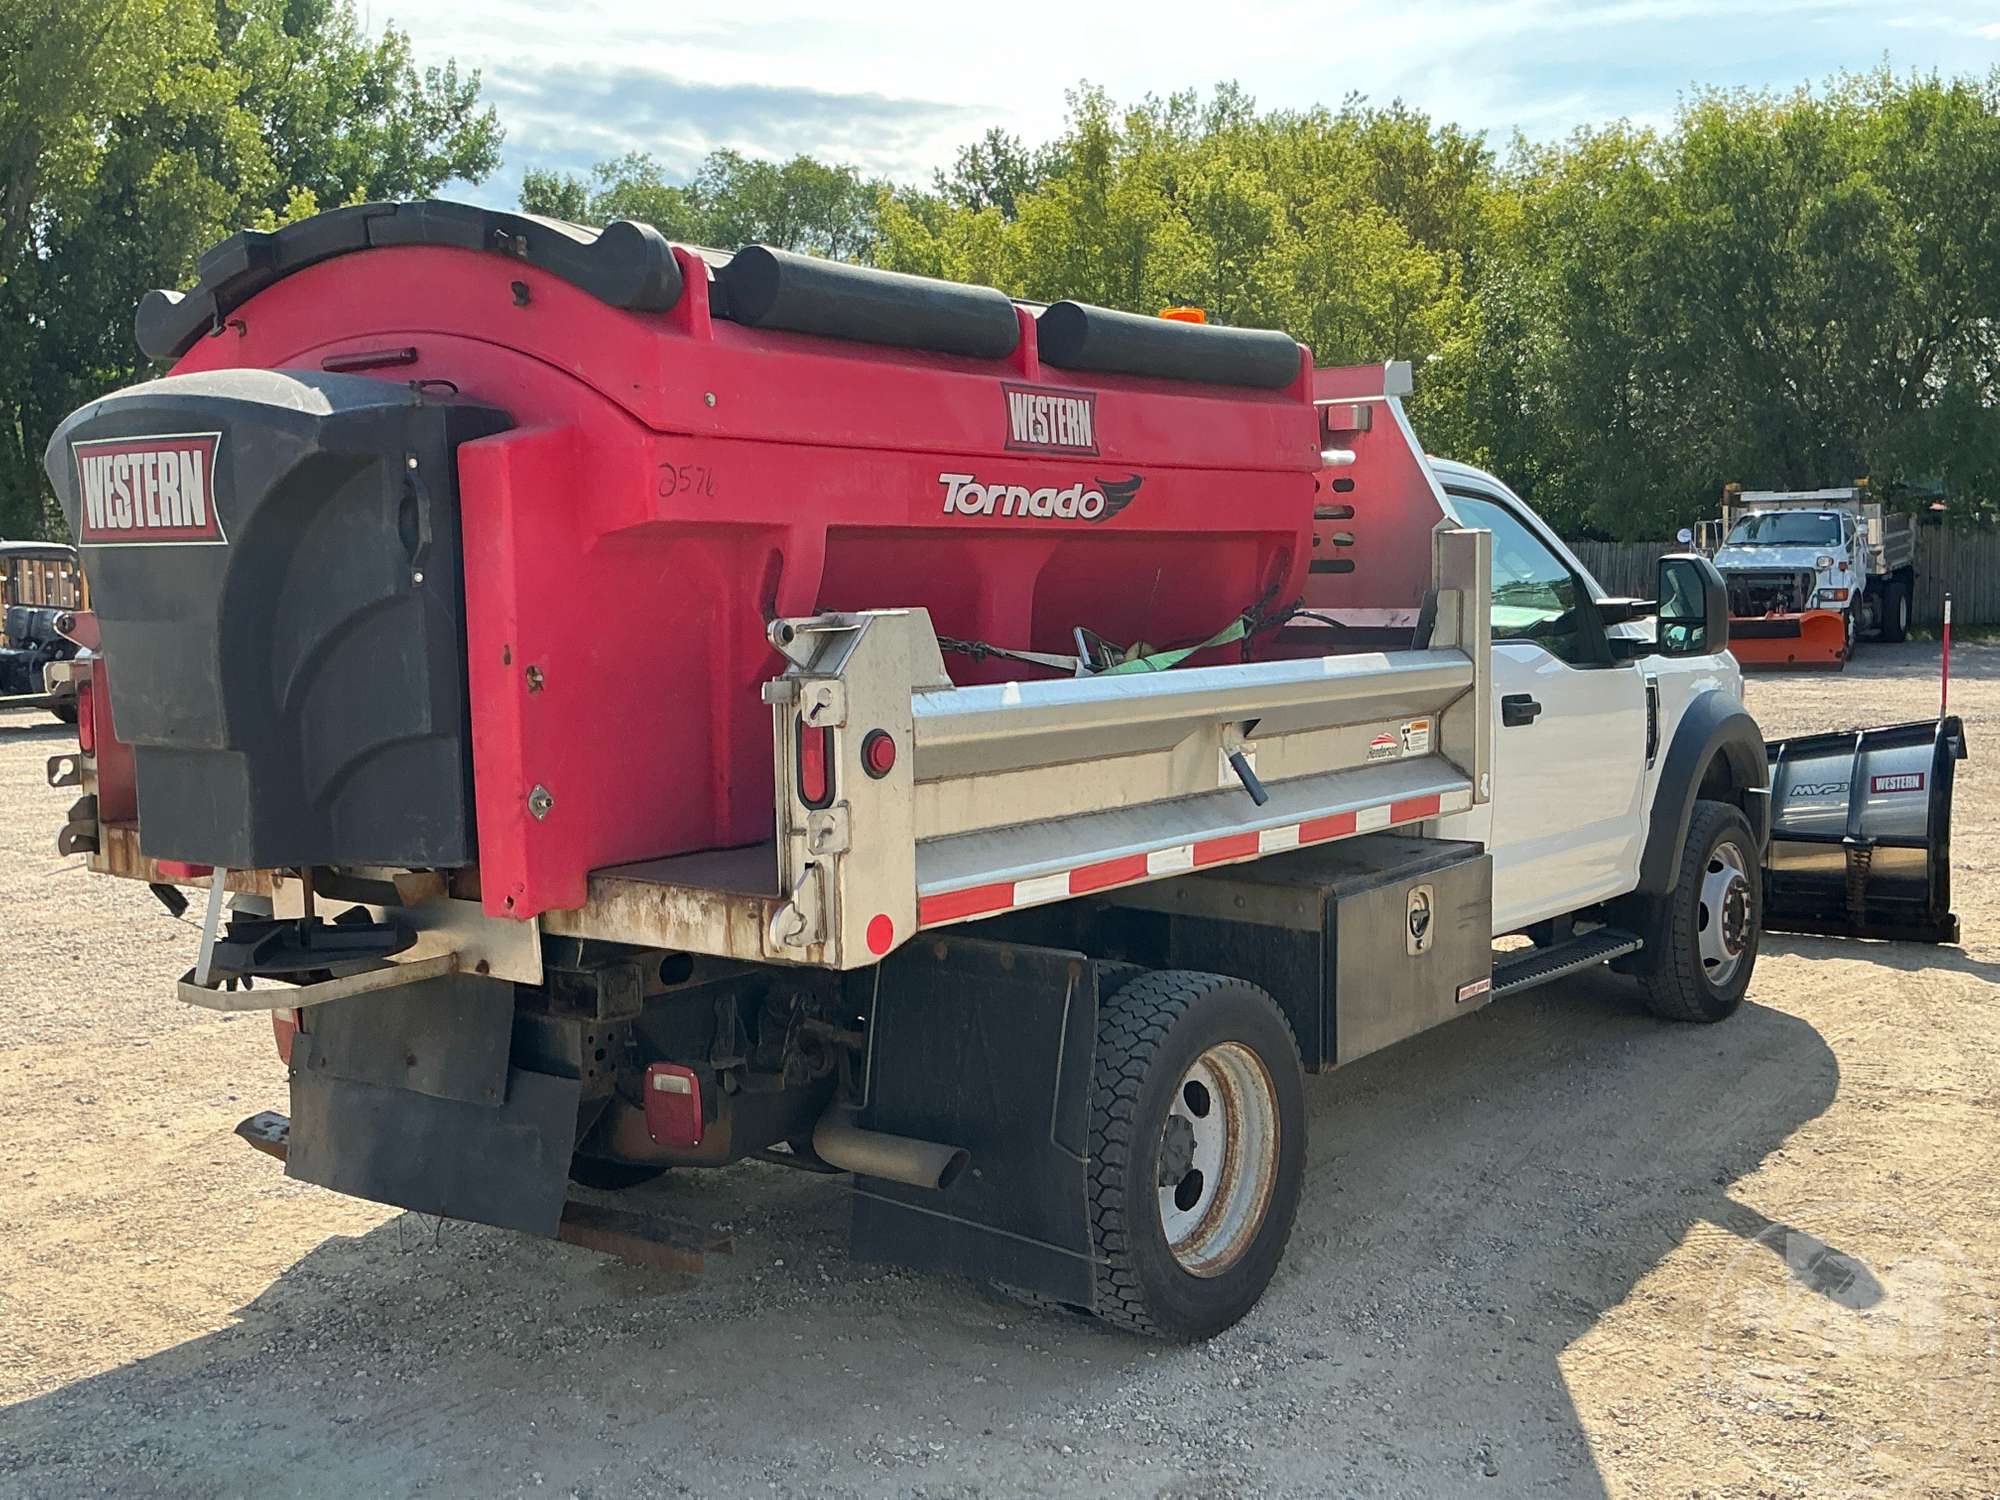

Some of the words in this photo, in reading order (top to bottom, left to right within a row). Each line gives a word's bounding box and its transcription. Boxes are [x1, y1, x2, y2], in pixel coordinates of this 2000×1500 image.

[1009, 392, 1092, 446] WESTERN
[82, 450, 206, 529] WESTERN
[939, 473, 1105, 519] Tornado
[1876, 775, 1920, 791] WESTERN
